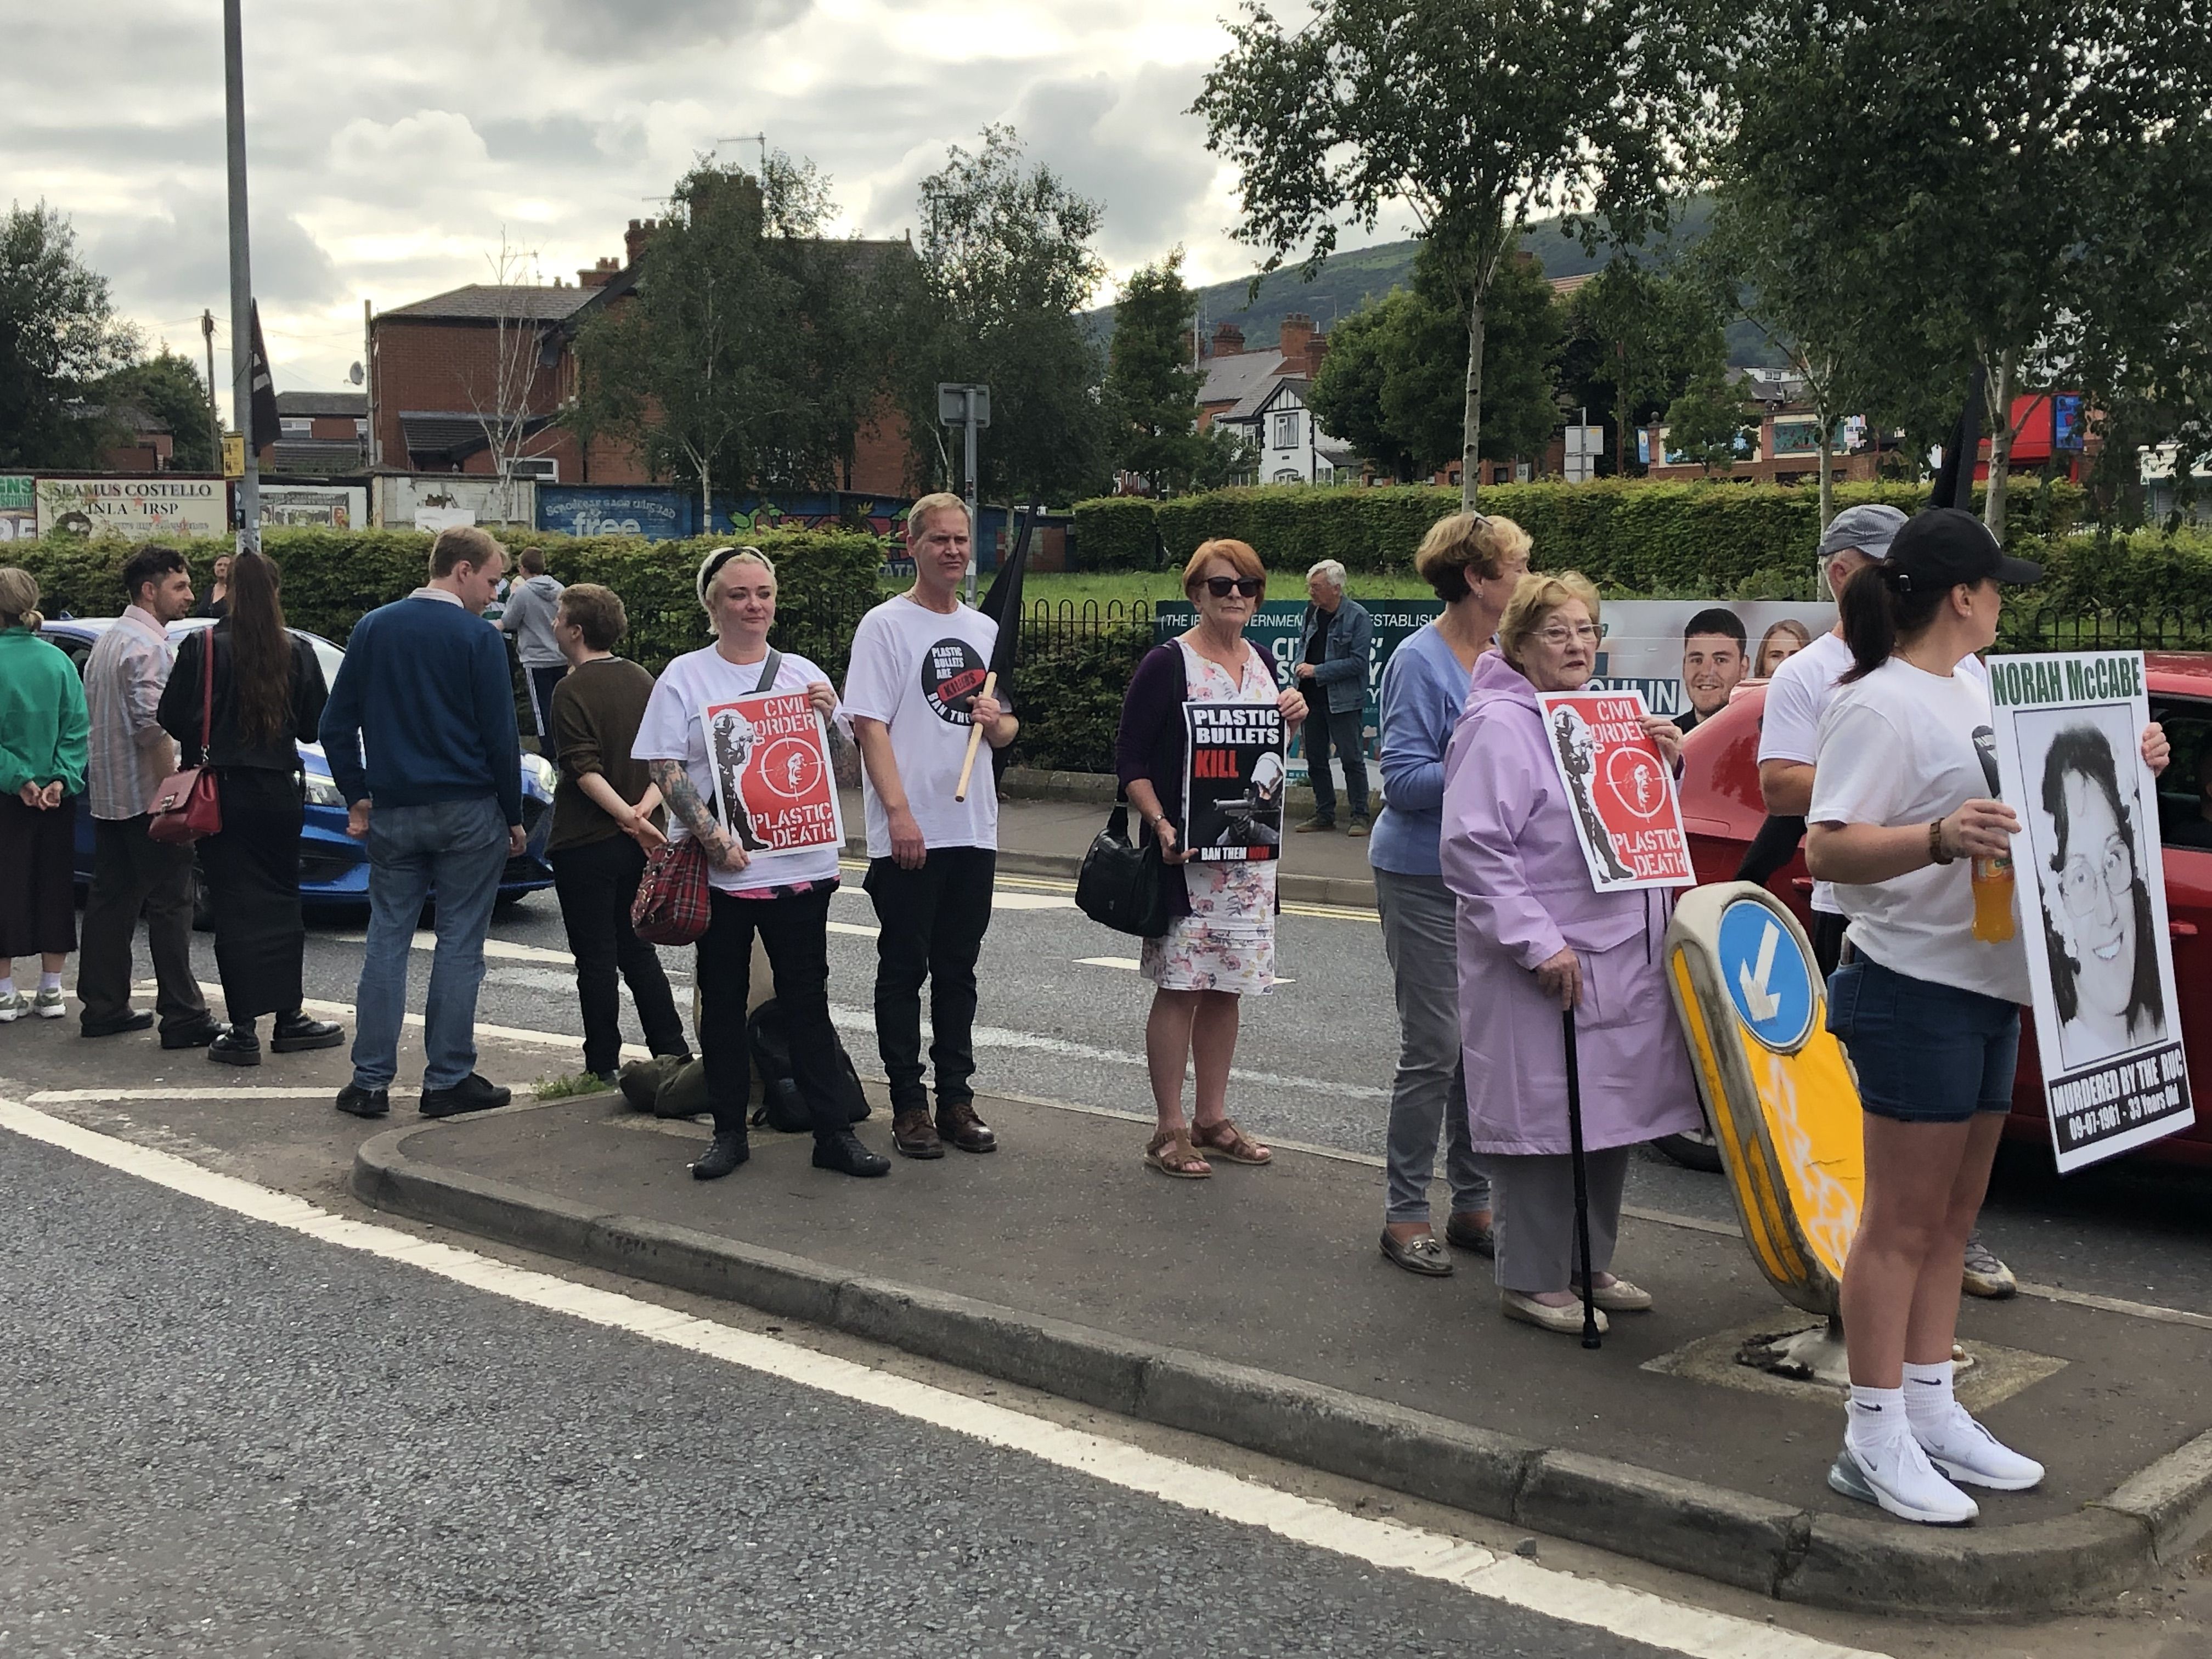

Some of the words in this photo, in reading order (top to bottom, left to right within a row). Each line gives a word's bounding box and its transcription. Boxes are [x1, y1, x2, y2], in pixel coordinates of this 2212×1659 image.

[126, 484, 212, 496] COSTELLO
[88, 503, 127, 515] INLA
[143, 503, 178, 515] IRSP
[932, 647, 963, 658] PLASTIC
[934, 657, 964, 668] BULLETS
[936, 668, 952, 679] ARE
[1991, 661, 2063, 706] NORAH
[2066, 657, 2142, 700] McCABE
[764, 696, 812, 717] CIVIL
[928, 692, 949, 715] BAN
[950, 709, 970, 724] THE
[1193, 709, 1280, 726] PLASTIC
[1596, 700, 1637, 721] CIVIL
[753, 714, 816, 737] ORDER
[1196, 727, 1279, 744] BULLETS
[1195, 749, 1239, 778] KILL
[752, 802, 832, 831] PLASTIC
[772, 822, 835, 847] DEATH
[1611, 828, 1681, 855] PLASTIC
[1201, 848, 1221, 860] BAN
[1223, 847, 1247, 860] THEM
[1634, 854, 1686, 877] DEATH
[2052, 1070, 2120, 1117] MURDERED
[2119, 1063, 2136, 1096] BY
[2136, 1057, 2160, 1090] THE
[2160, 1048, 2183, 1081] RUC
[2128, 1096, 2141, 1120] 33
[2141, 1091, 2165, 1115] Years
[2165, 1083, 2180, 1107] Old
